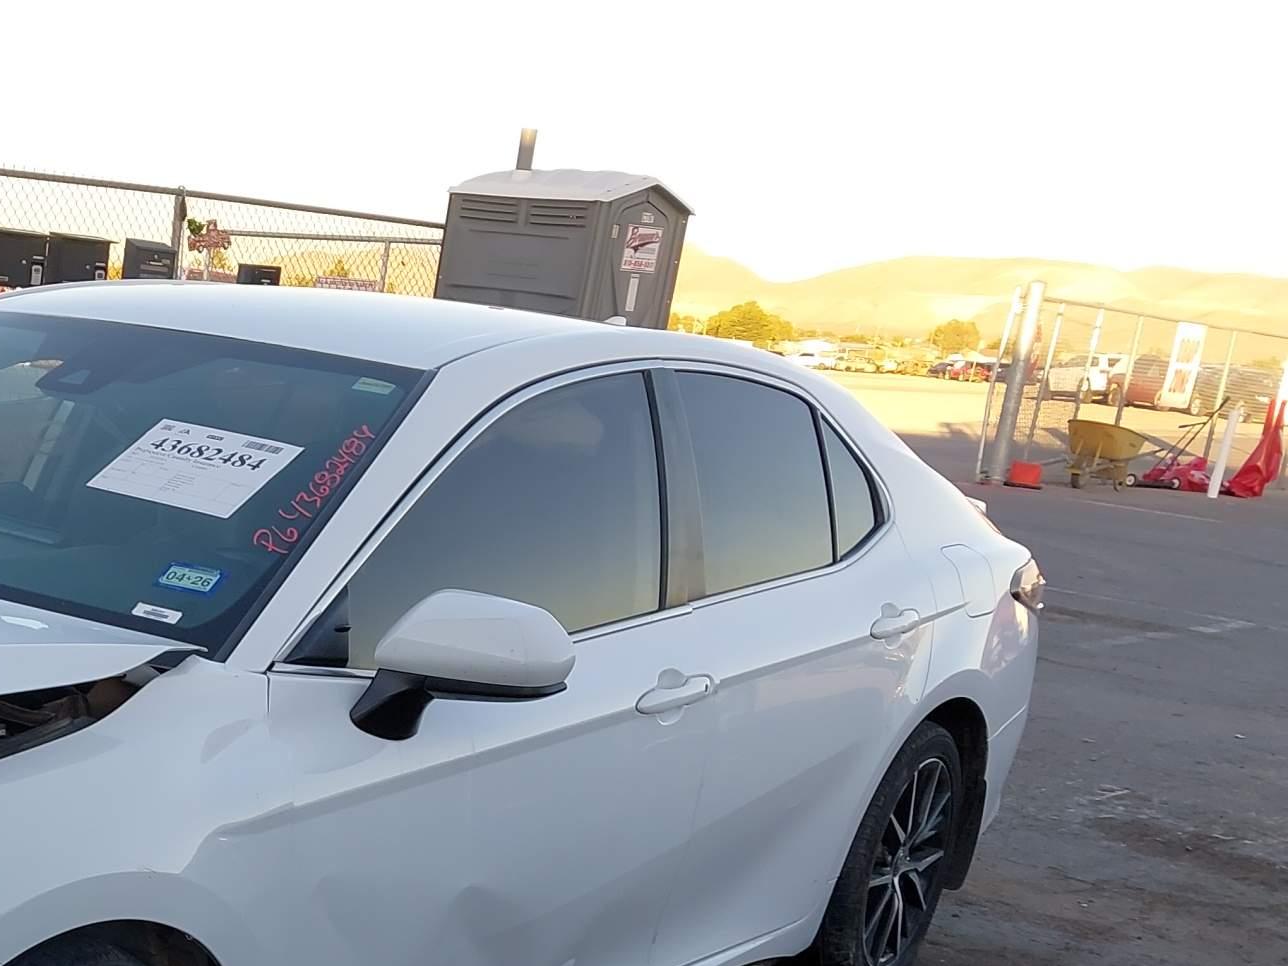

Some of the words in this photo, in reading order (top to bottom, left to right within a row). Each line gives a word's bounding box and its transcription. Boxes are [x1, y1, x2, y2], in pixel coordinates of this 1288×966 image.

[150, 437, 267, 471] 43682484
[166, 571, 186, 582] 04
[190, 575, 213, 587] 26
